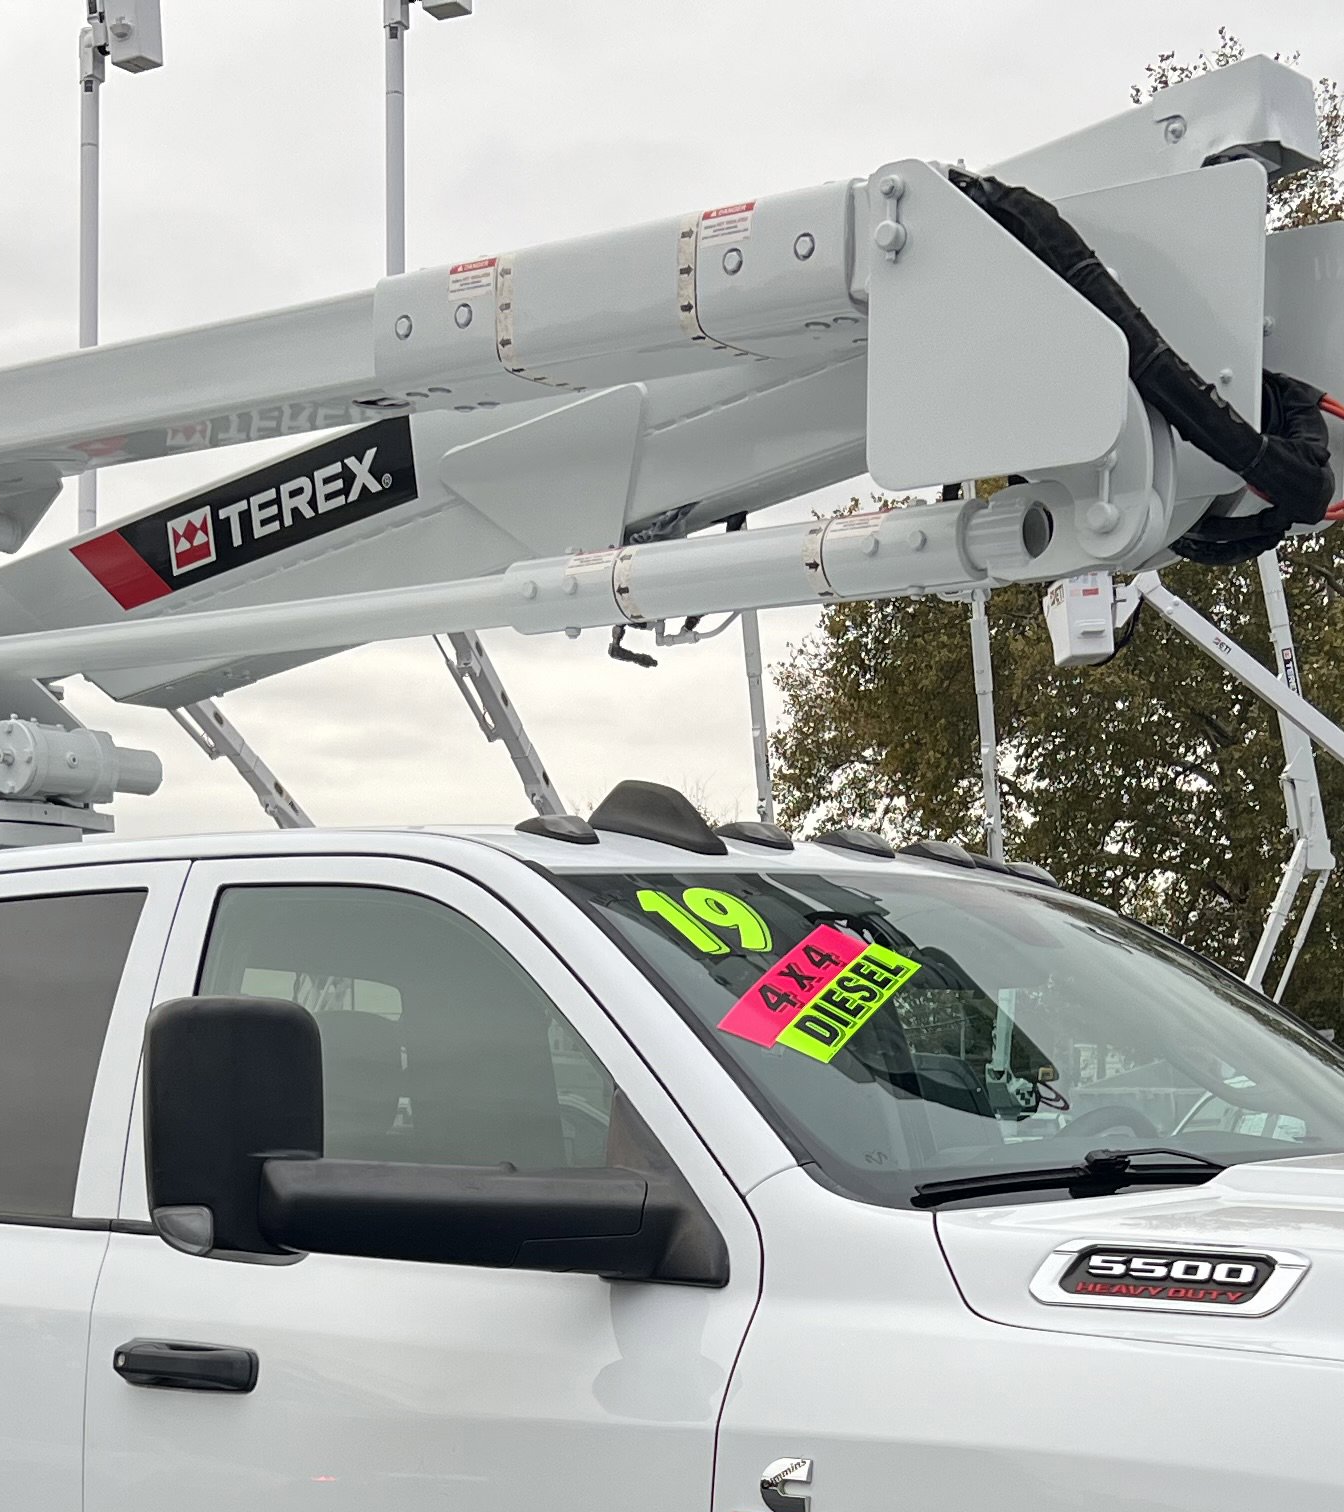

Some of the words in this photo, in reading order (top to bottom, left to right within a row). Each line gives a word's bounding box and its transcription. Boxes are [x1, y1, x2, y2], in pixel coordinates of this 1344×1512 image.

[218, 446, 383, 548] TEREX
[636, 887, 774, 955] 19
[793, 954, 912, 1048] DIESEL
[1075, 1281, 1167, 1297] HEAVY
[1167, 1287, 1246, 1302] DUTY
[1087, 1254, 1258, 1284] 5500
